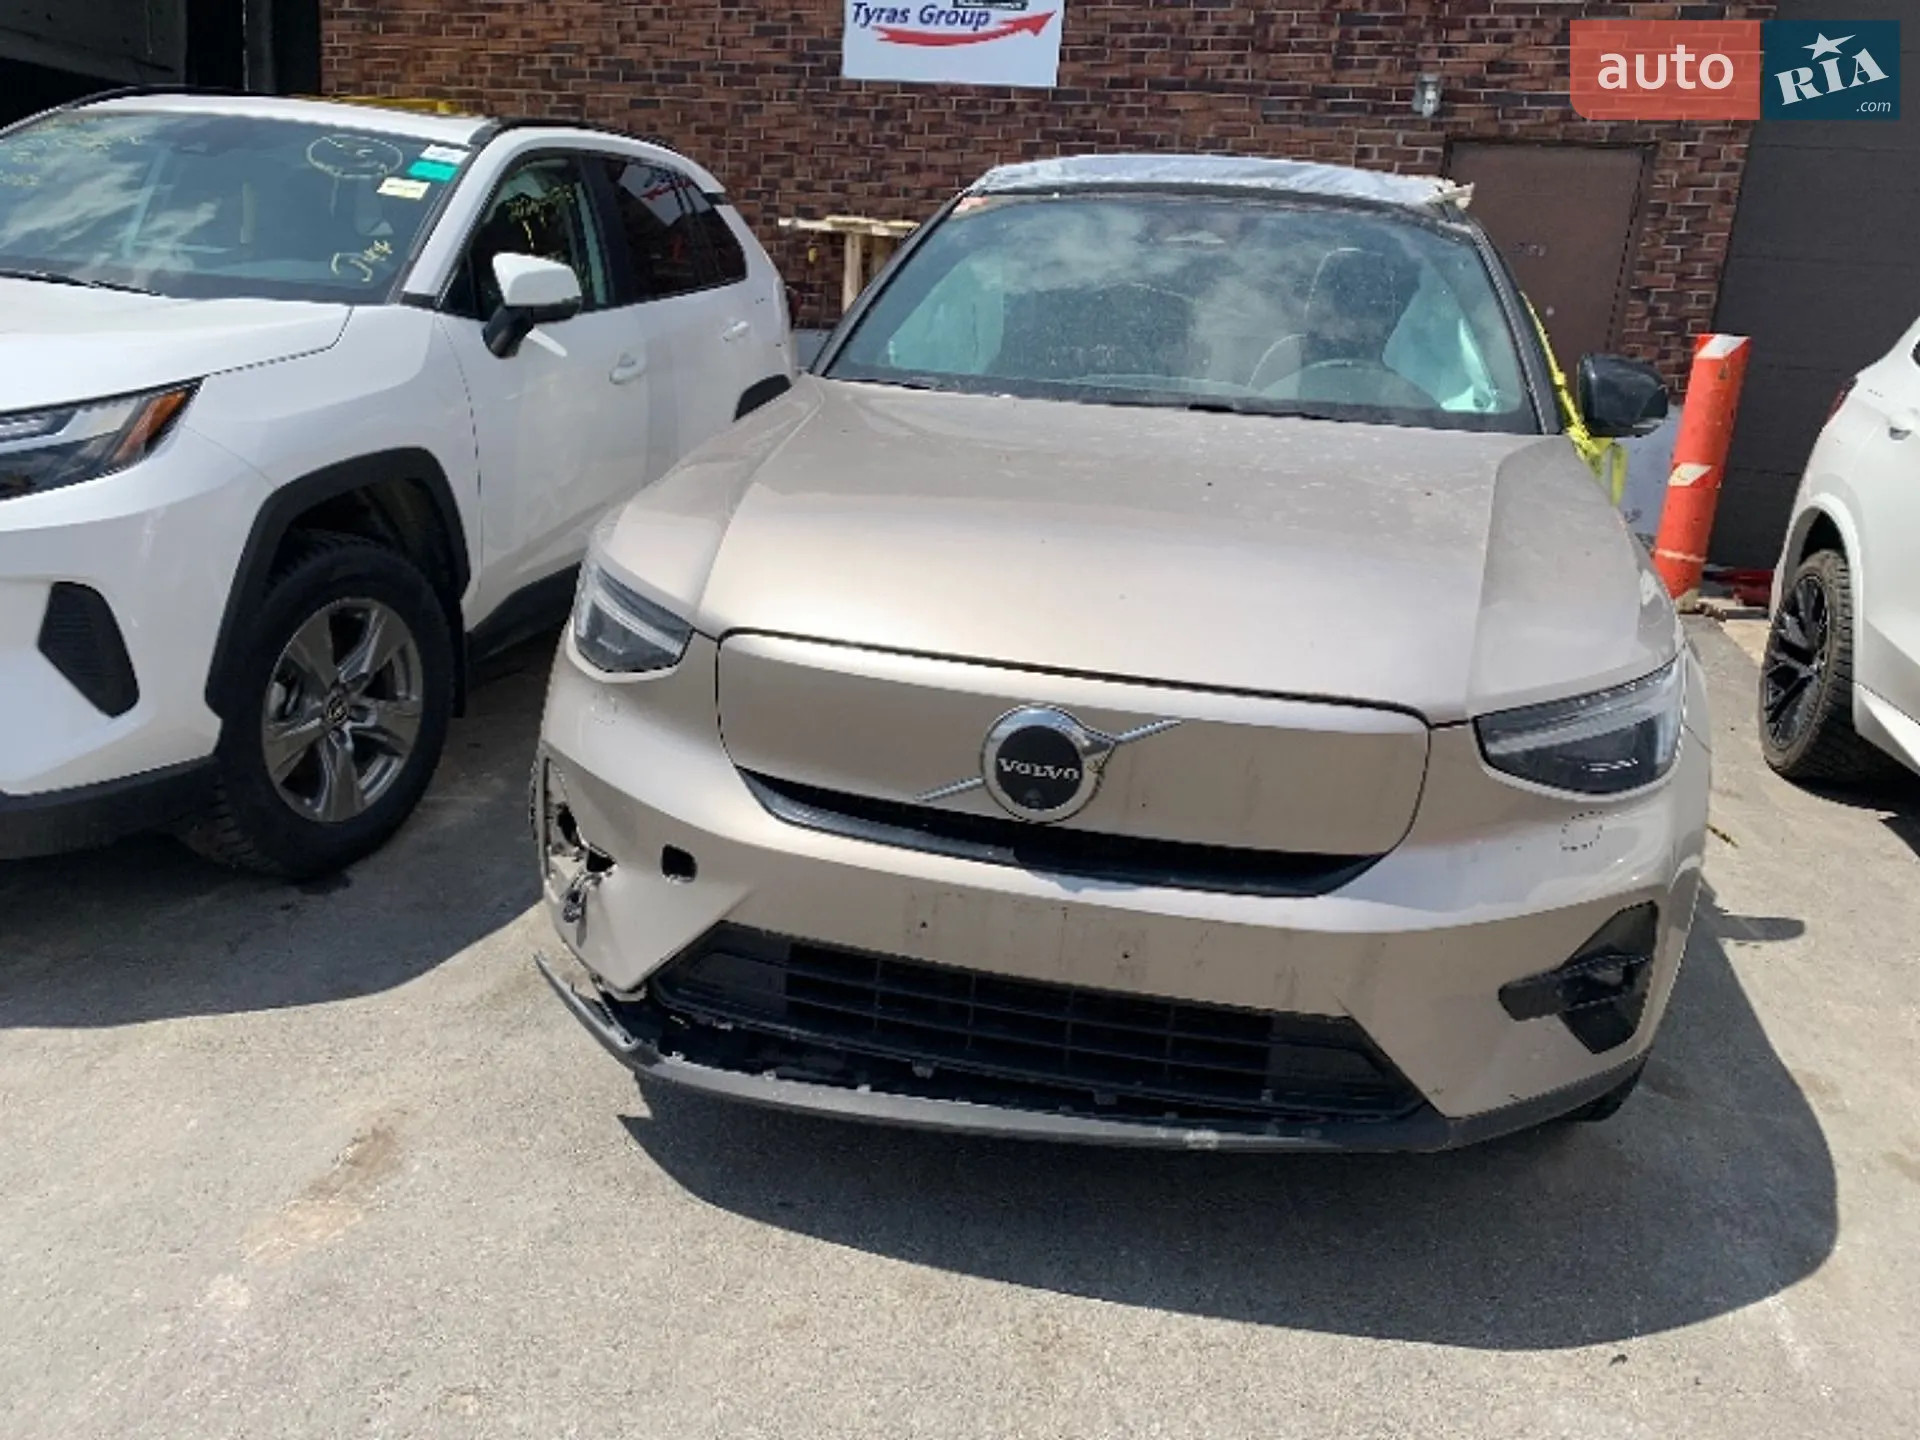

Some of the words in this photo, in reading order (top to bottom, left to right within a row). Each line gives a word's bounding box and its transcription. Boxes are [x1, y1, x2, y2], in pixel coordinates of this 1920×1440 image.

[852, 2, 910, 28] Tyras
[919, 4, 991, 31] Group
[998, 757, 1081, 781] VOLVO
